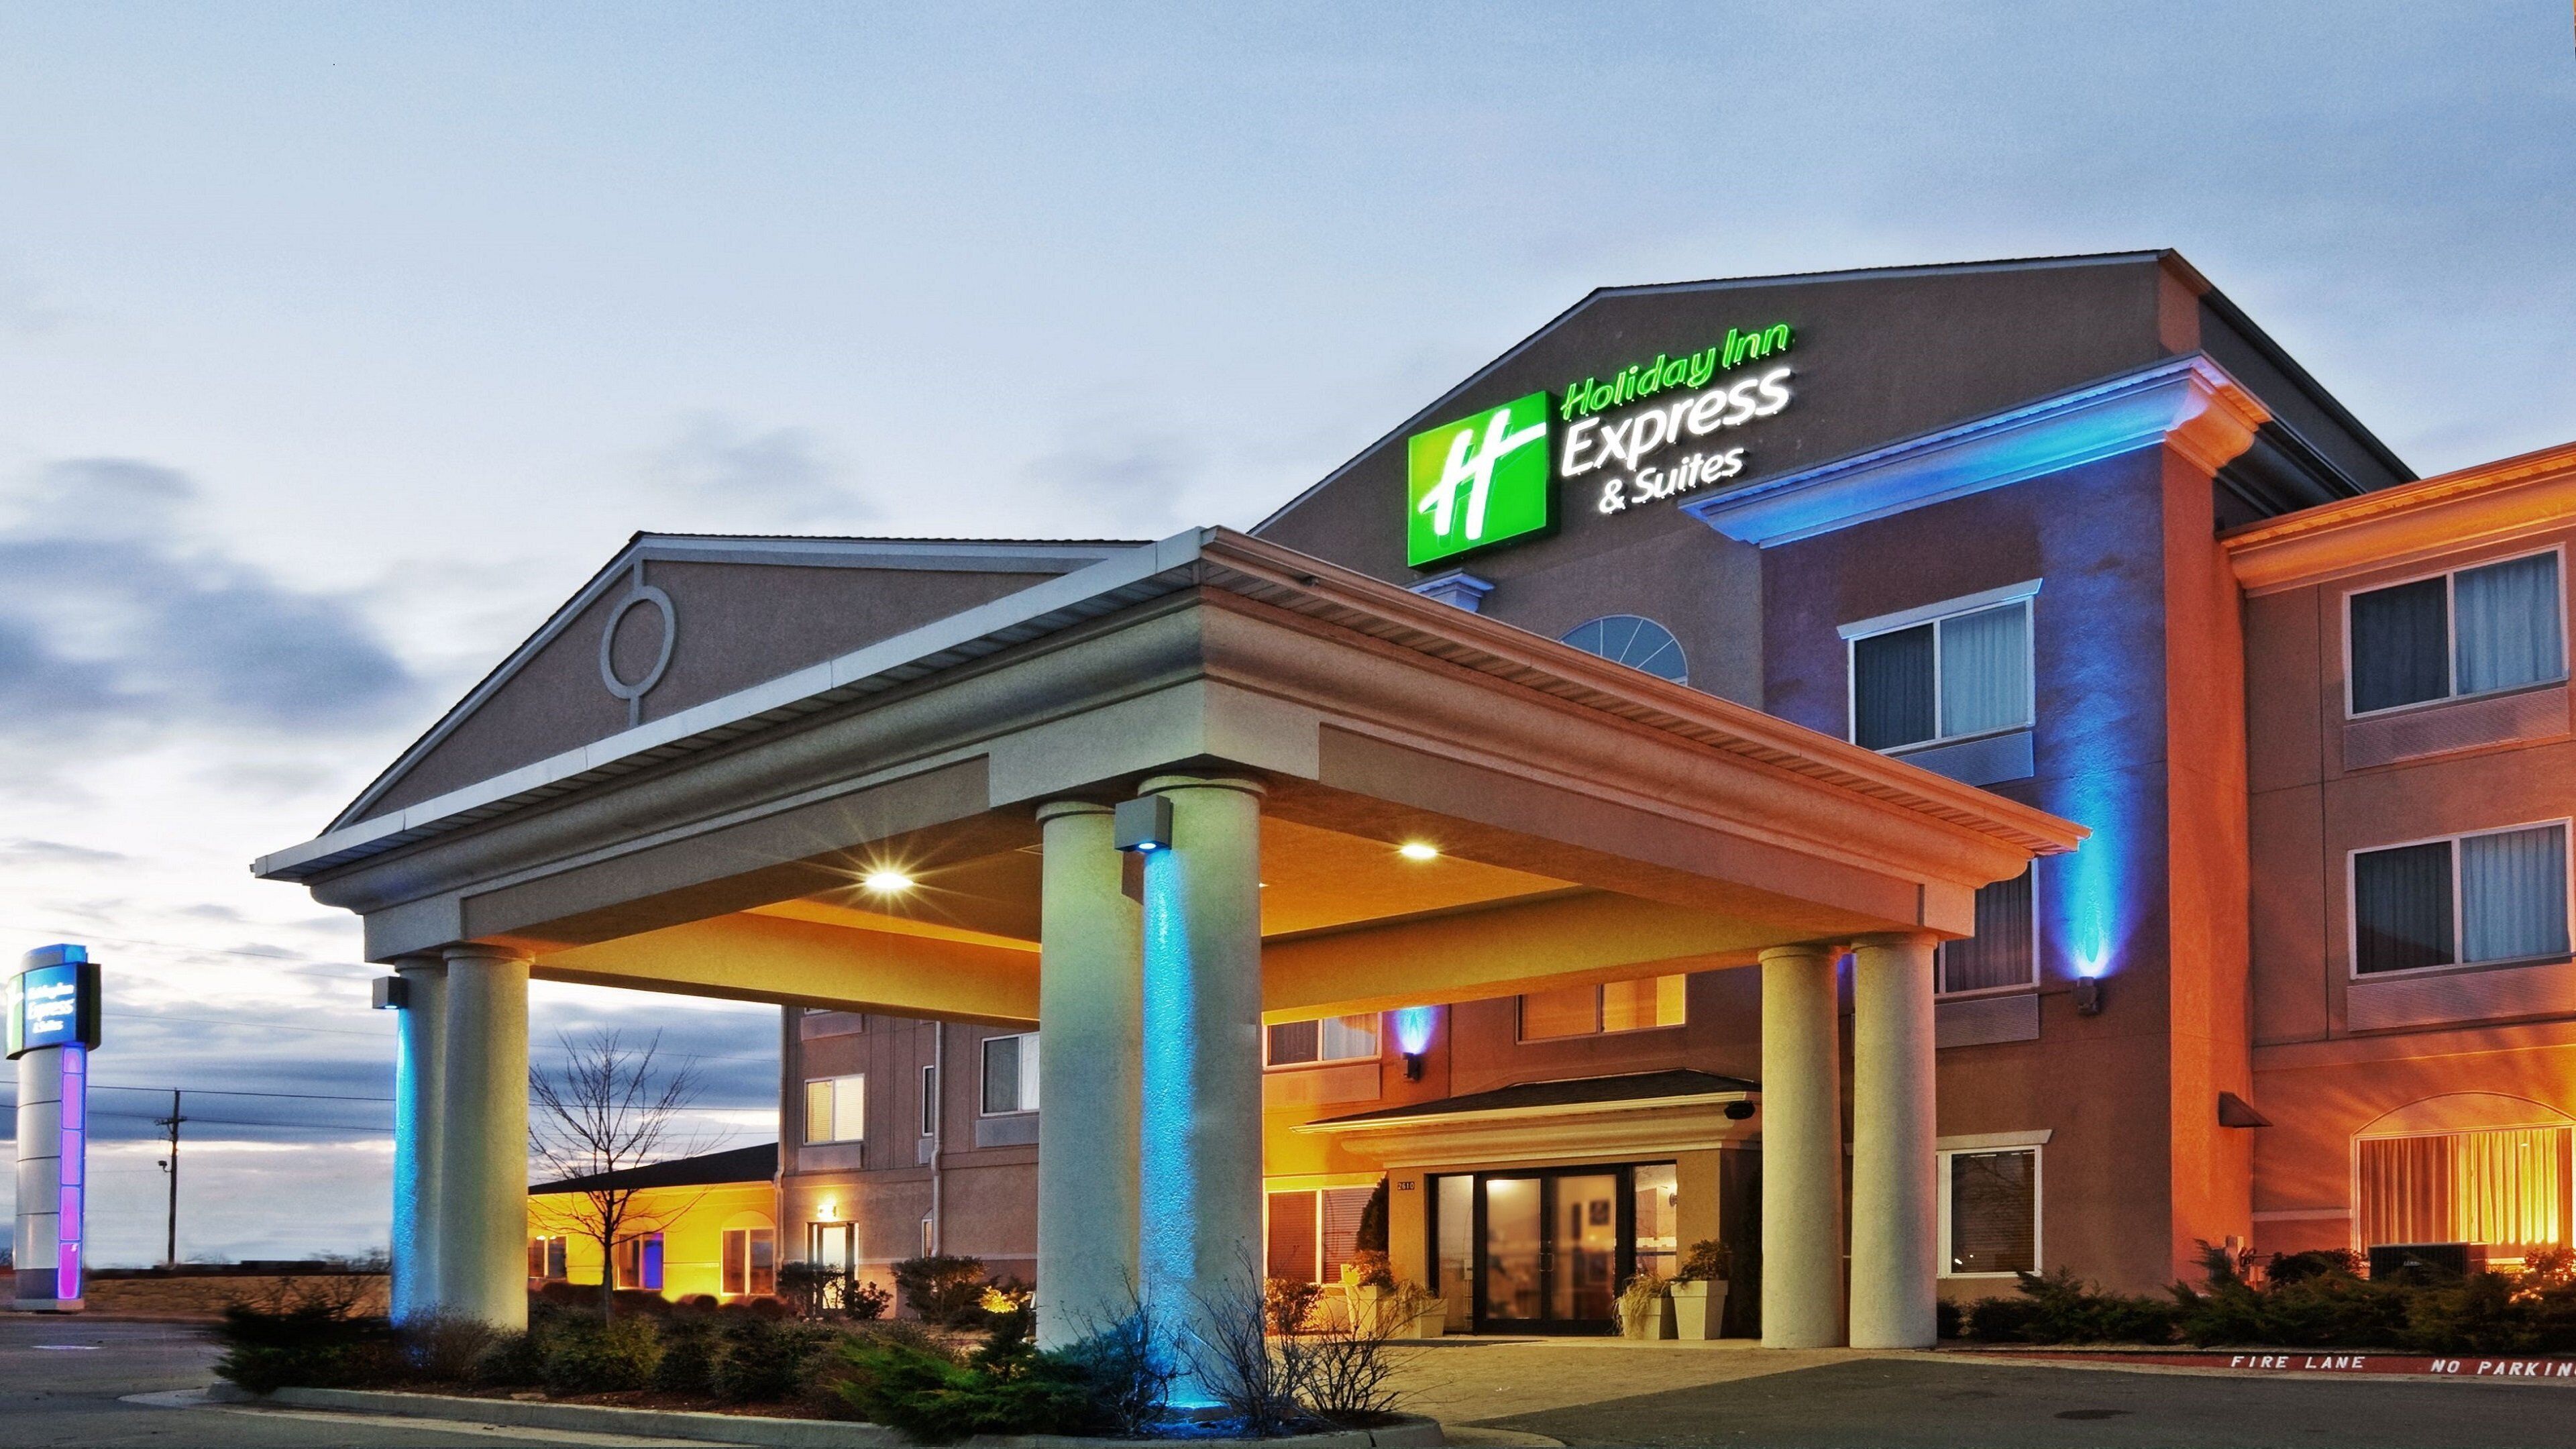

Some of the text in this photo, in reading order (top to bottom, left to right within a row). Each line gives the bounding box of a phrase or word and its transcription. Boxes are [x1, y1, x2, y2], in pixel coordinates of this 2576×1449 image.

[1560, 324, 1789, 421] Holiday Inn
[1561, 368, 1791, 477] Express
[1598, 447, 1745, 514] & Suites
[1397, 1182, 1415, 1190] 2610
[2231, 1356, 2576, 1377] FIRE LANE NO PARKIN
